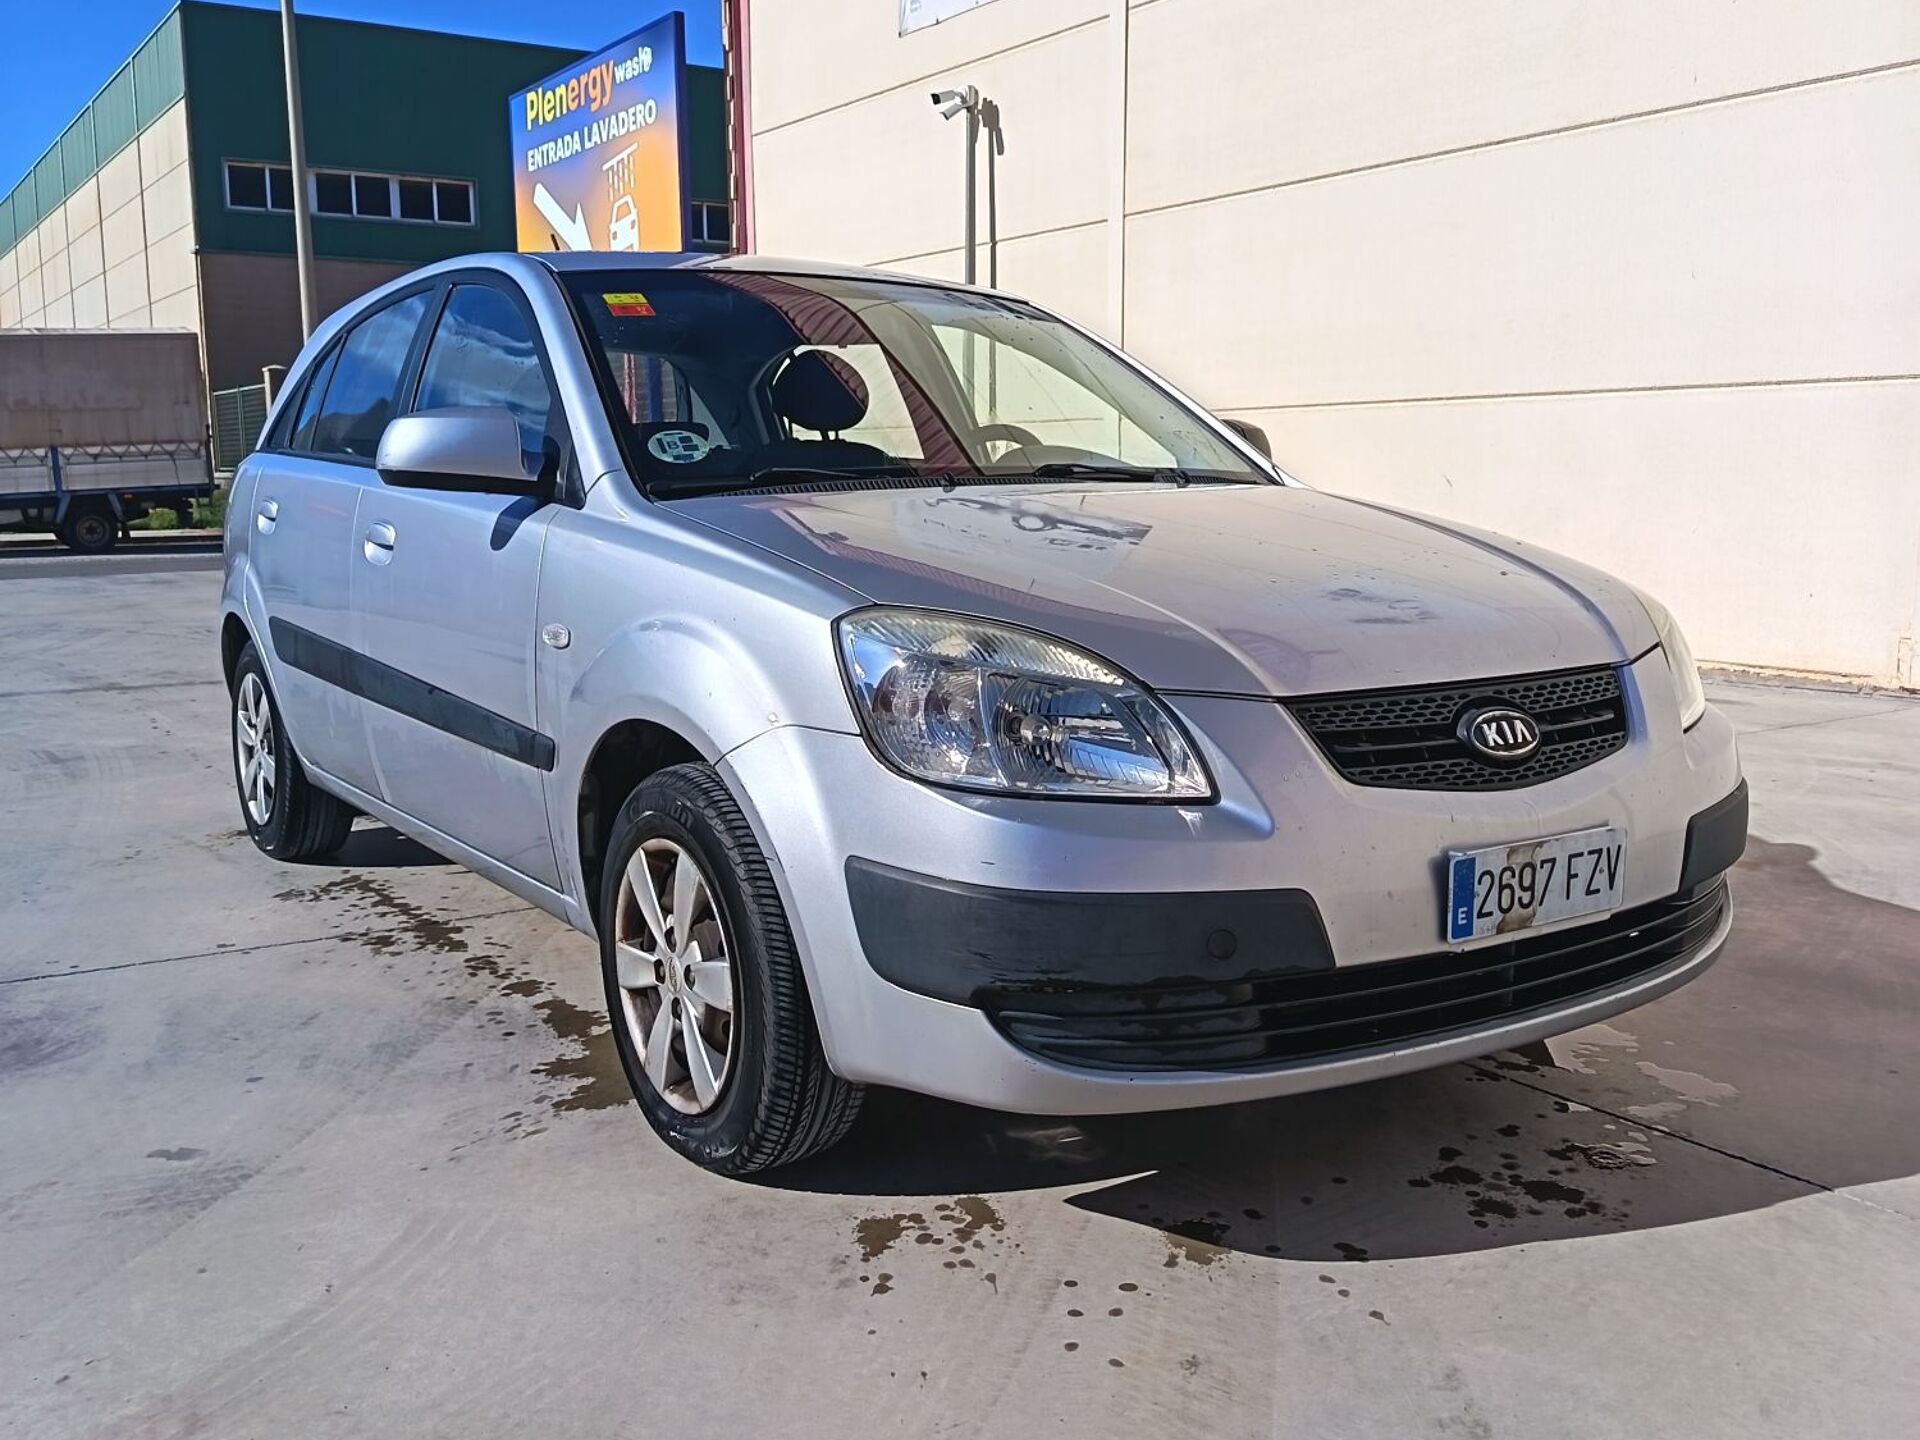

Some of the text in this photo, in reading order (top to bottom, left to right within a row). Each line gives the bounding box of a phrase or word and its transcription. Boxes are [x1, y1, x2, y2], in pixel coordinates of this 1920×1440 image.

[526, 59, 614, 130] Plenergy
[527, 99, 656, 172] ENTRADA LAVADERO
[1481, 719, 1533, 747] KIA
[1458, 907, 1468, 925] E
[1476, 844, 1622, 919] 2697 FZV
